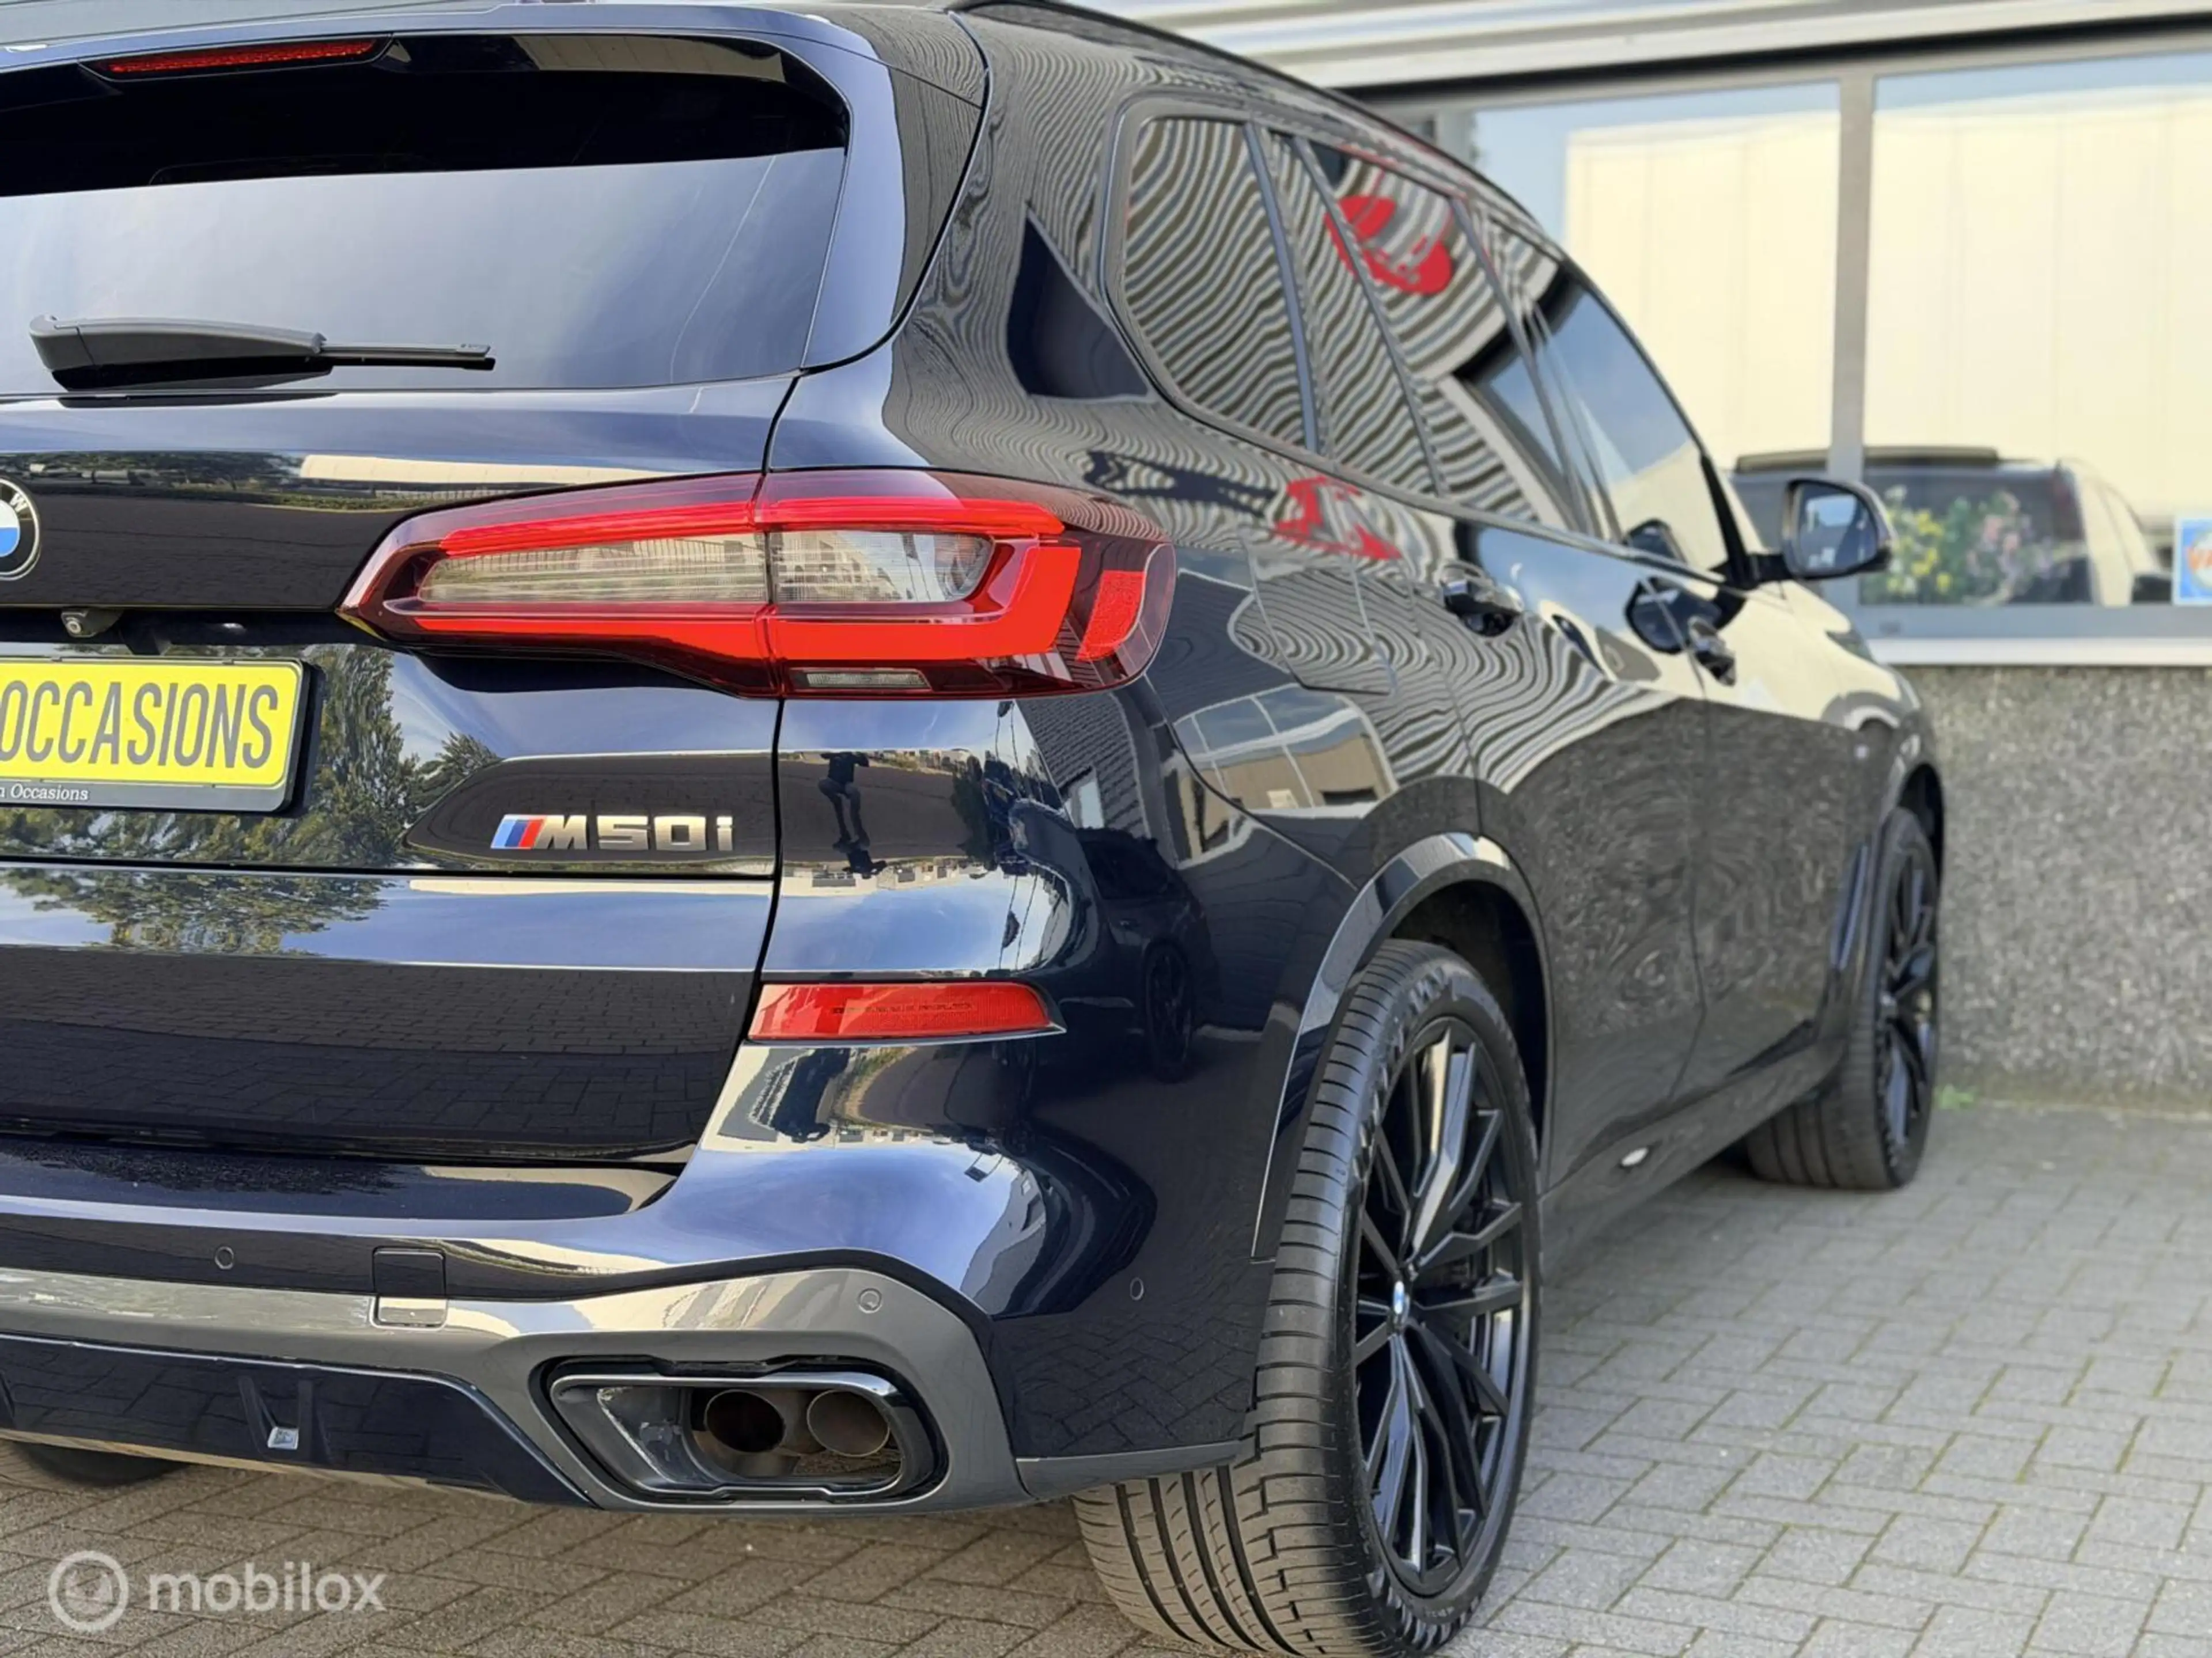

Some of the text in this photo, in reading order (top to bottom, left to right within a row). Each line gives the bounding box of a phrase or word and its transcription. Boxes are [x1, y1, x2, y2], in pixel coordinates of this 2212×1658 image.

[0, 680, 278, 769] OCCASIONS
[10, 783, 89, 801] Occasions
[531, 814, 733, 851] M50i
